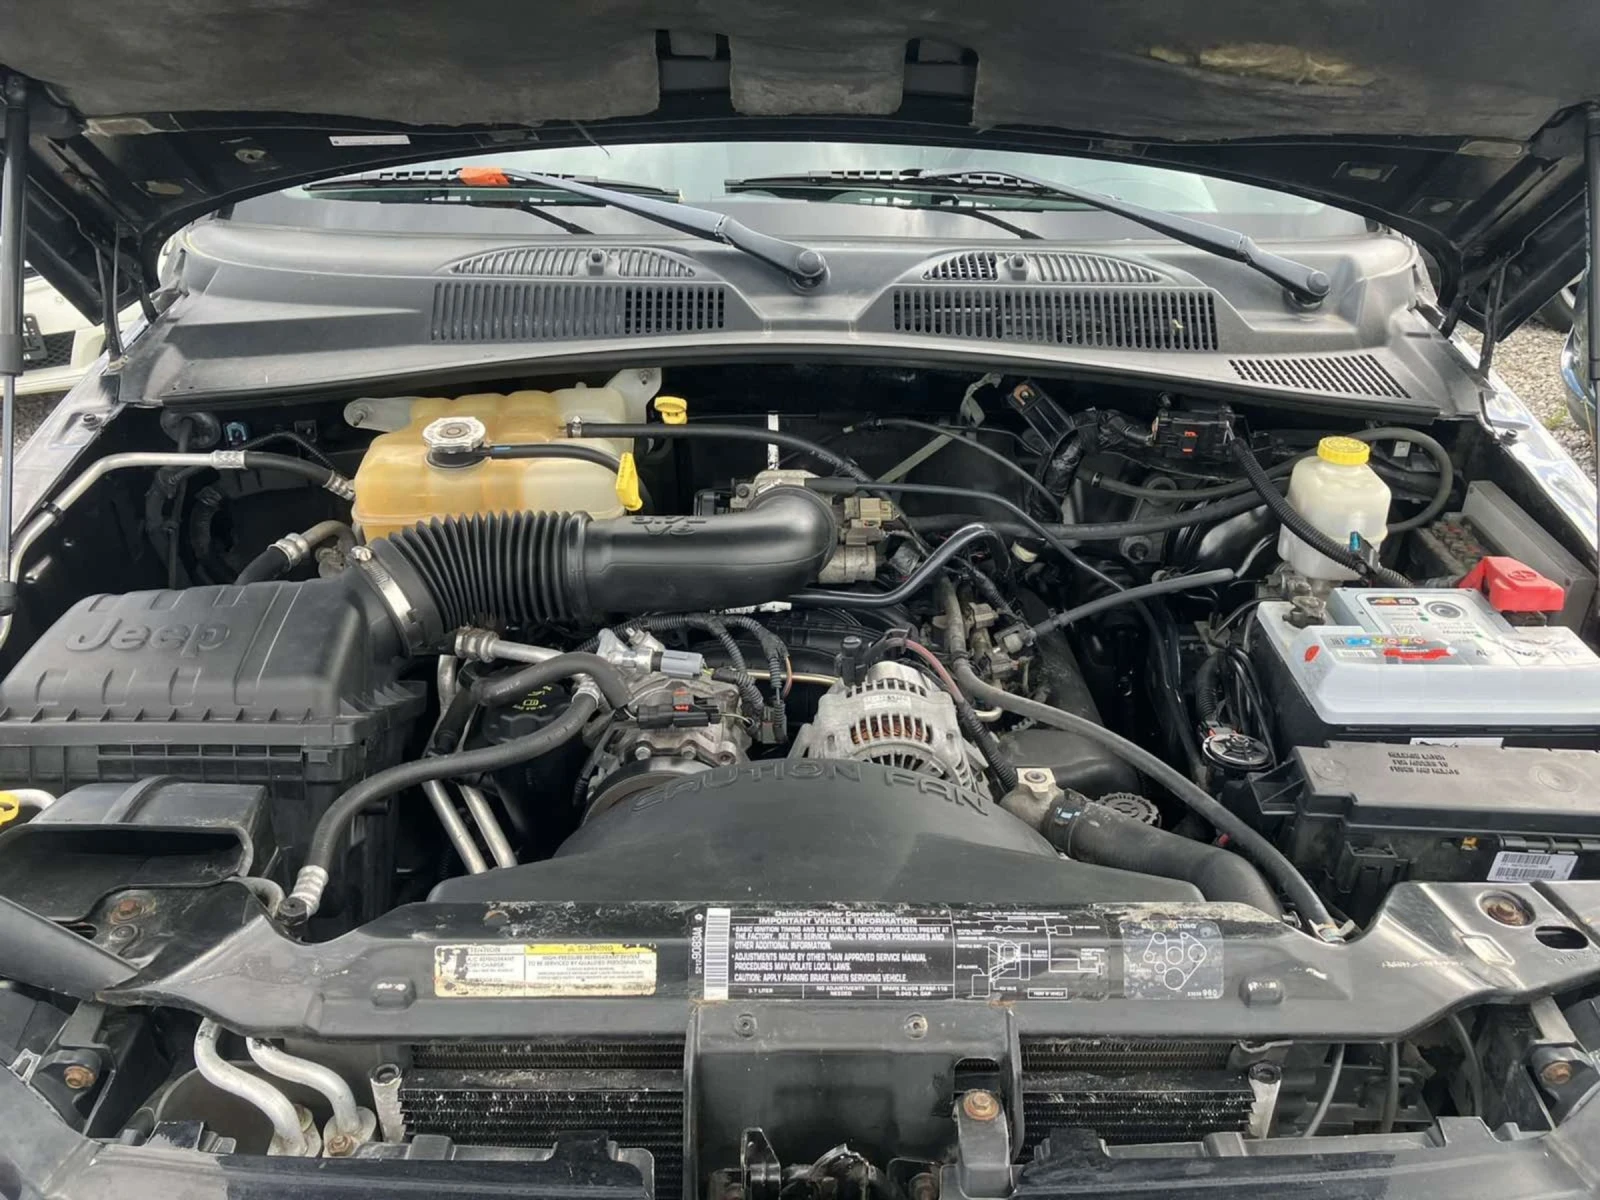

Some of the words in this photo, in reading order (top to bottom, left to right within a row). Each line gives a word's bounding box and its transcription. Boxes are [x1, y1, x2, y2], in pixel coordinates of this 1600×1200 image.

[65, 618, 231, 658] Jeep
[630, 759, 862, 812] CAUTION
[884, 769, 989, 817] FAN
[774, 910, 843, 918] DaimlerChrysler
[845, 910, 896, 918] Corporation
[758, 917, 812, 925] IMPORTANT
[814, 917, 851, 925] VEHICLE
[854, 917, 917, 925] INFORMATION
[734, 941, 754, 950] OTHER
[755, 941, 789, 950] ADDITIONAL
[790, 941, 832, 950] INFORMATION.
[734, 953, 777, 961] ADJUSTMENTS
[779, 953, 796, 961] MADE
[797, 953, 805, 961] BY
[806, 953, 826, 961] OTHER
[826, 953, 843, 961] THAN
[844, 953, 875, 961] APPROVED
[876, 953, 900, 961] SERVICE
[901, 953, 926, 961] MANUAL
[734, 962, 773, 971] PROCEDURES
[774, 962, 788, 971] MAY
[788, 962, 813, 971] VIOLATE
[813, 962, 832, 971] LOCAL
[833, 962, 851, 971] LAWS.
[734, 973, 762, 982] CAUTION:
[762, 973, 782, 982] APPLY
[782, 973, 808, 982] PARKING
[809, 973, 829, 982] BRAKE
[830, 973, 849, 982] WHEN
[850, 973, 881, 982] SERVICING
[882, 973, 908, 982] VEHICLE.
